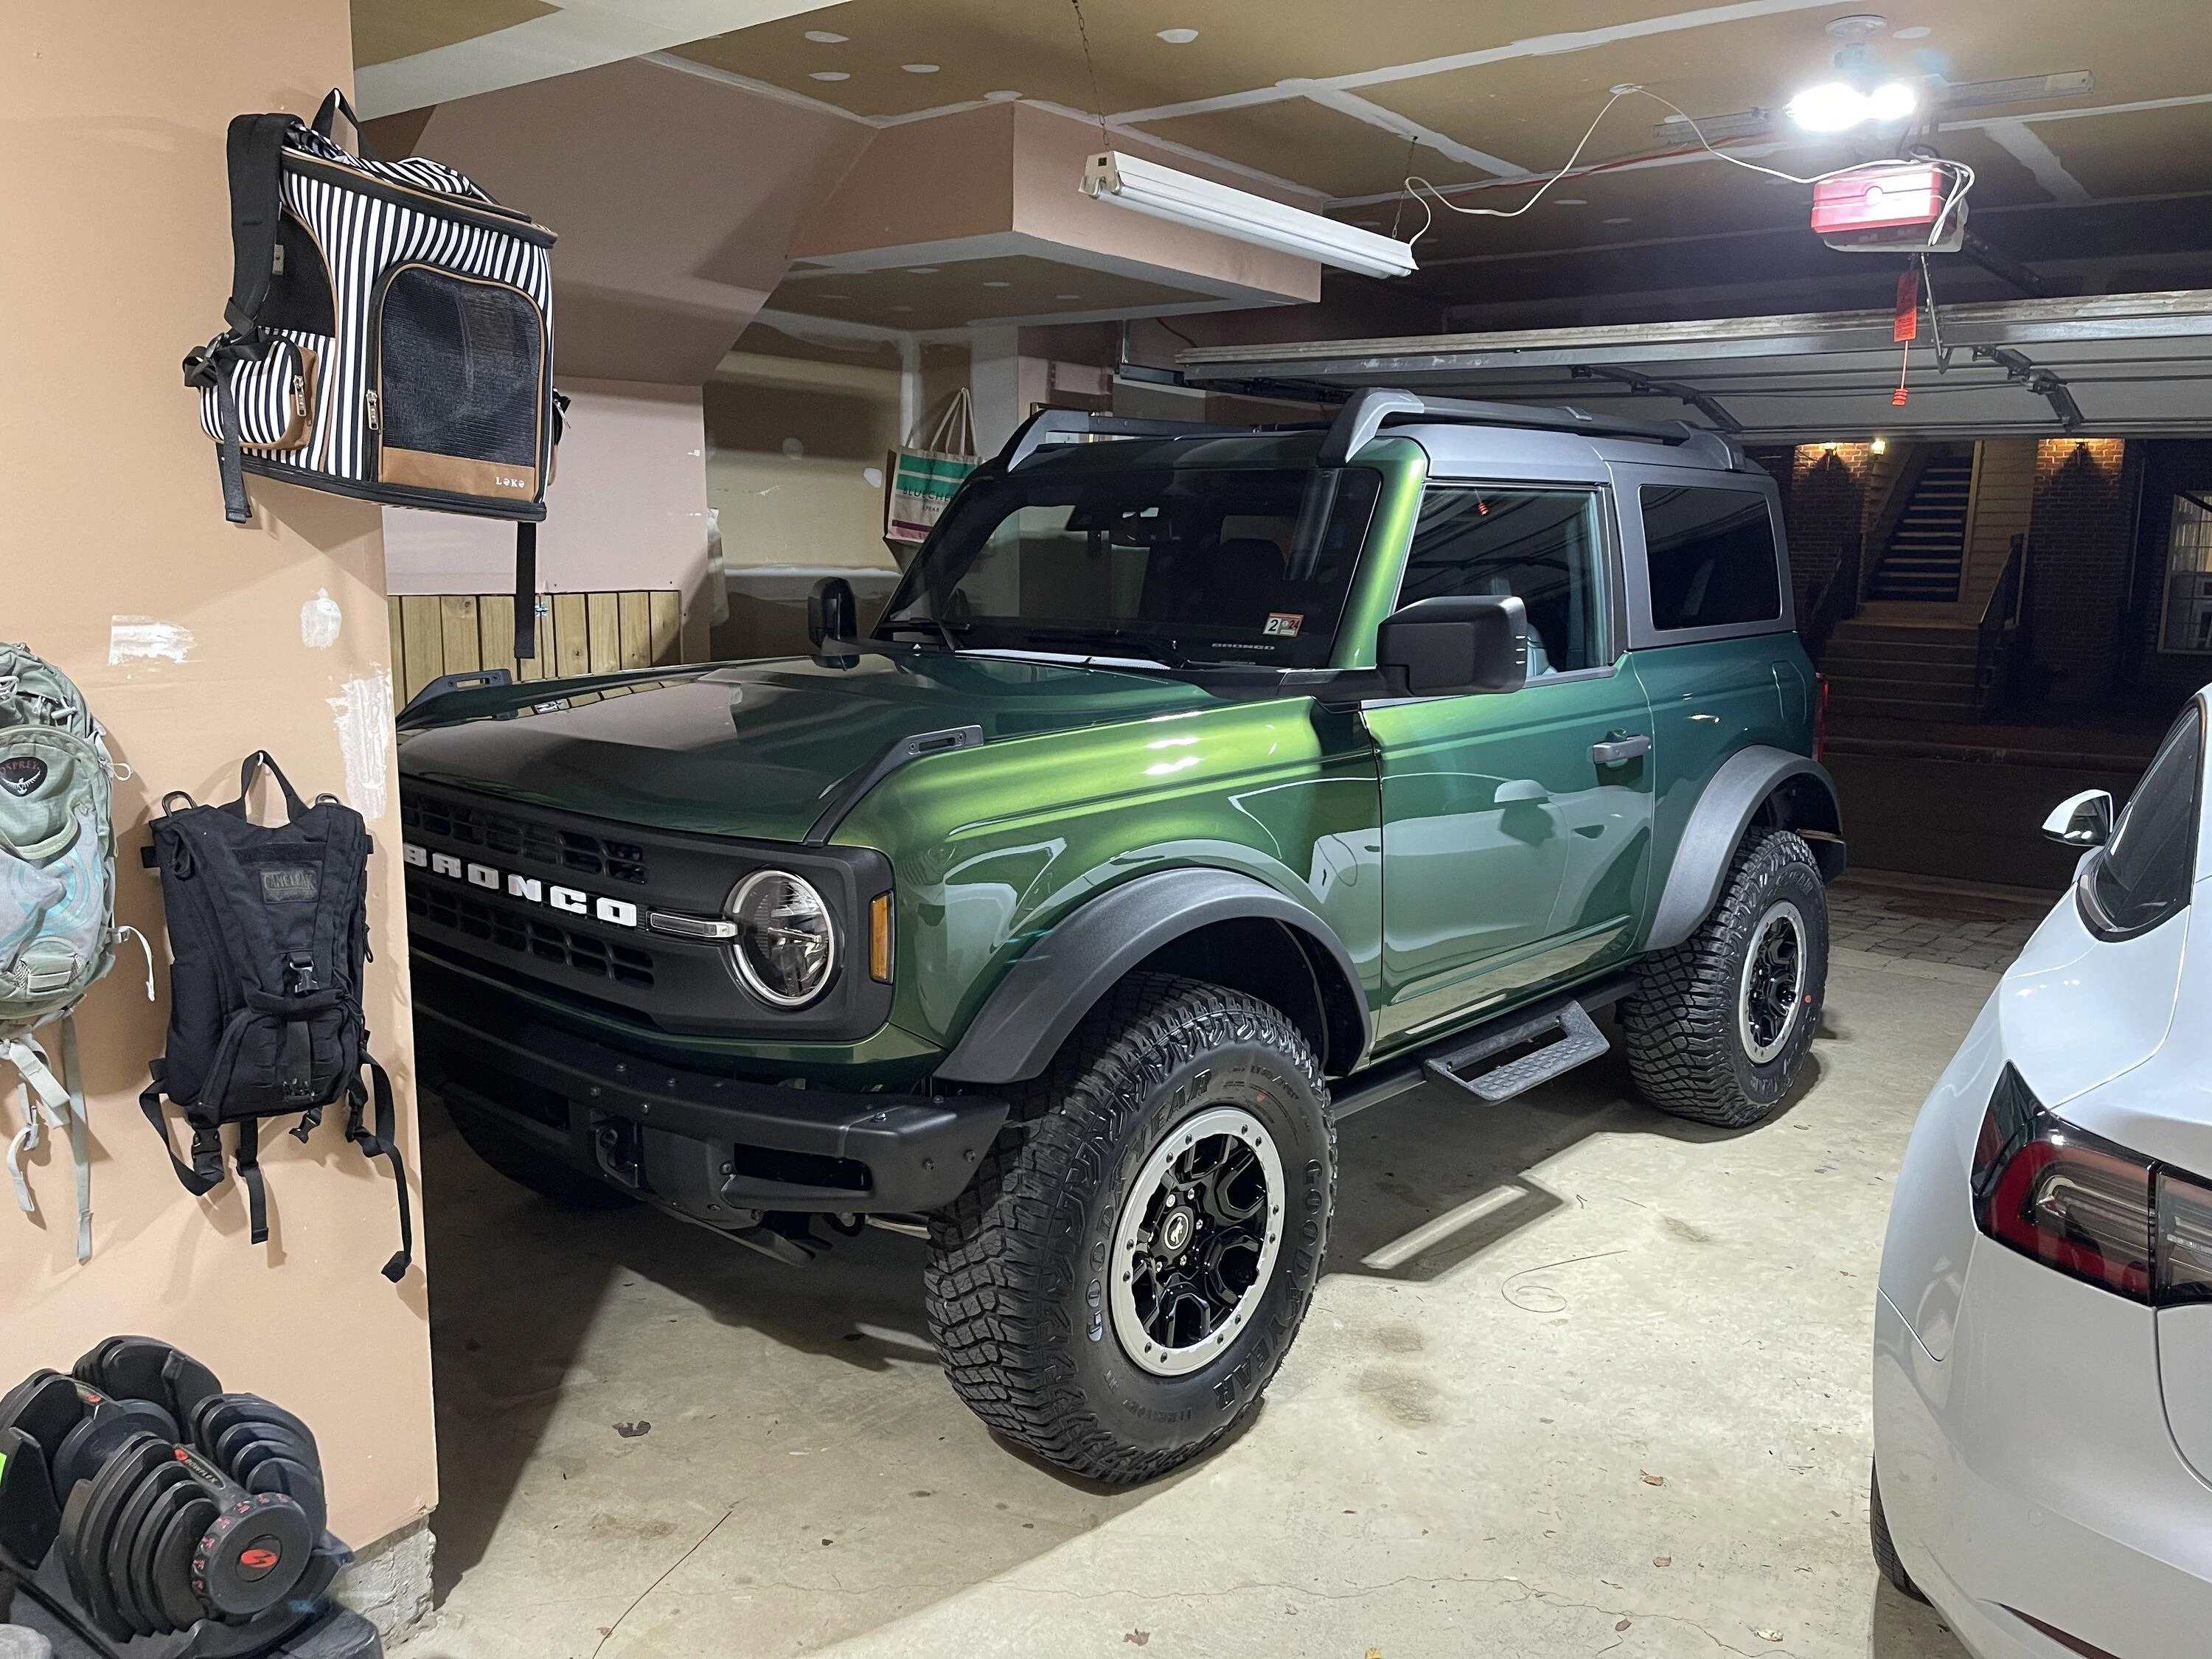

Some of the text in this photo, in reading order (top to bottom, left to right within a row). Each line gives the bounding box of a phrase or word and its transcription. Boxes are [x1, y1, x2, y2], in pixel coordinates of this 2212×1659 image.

[1267, 619, 1301, 632] 2 24
[0, 760, 39, 775] OSPREY
[264, 874, 316, 891] CAMELBAK
[403, 843, 637, 927] BRONCO
[1087, 1068, 1212, 1342] GOODYEAR
[1213, 1158, 1322, 1411] GOODYEAR
